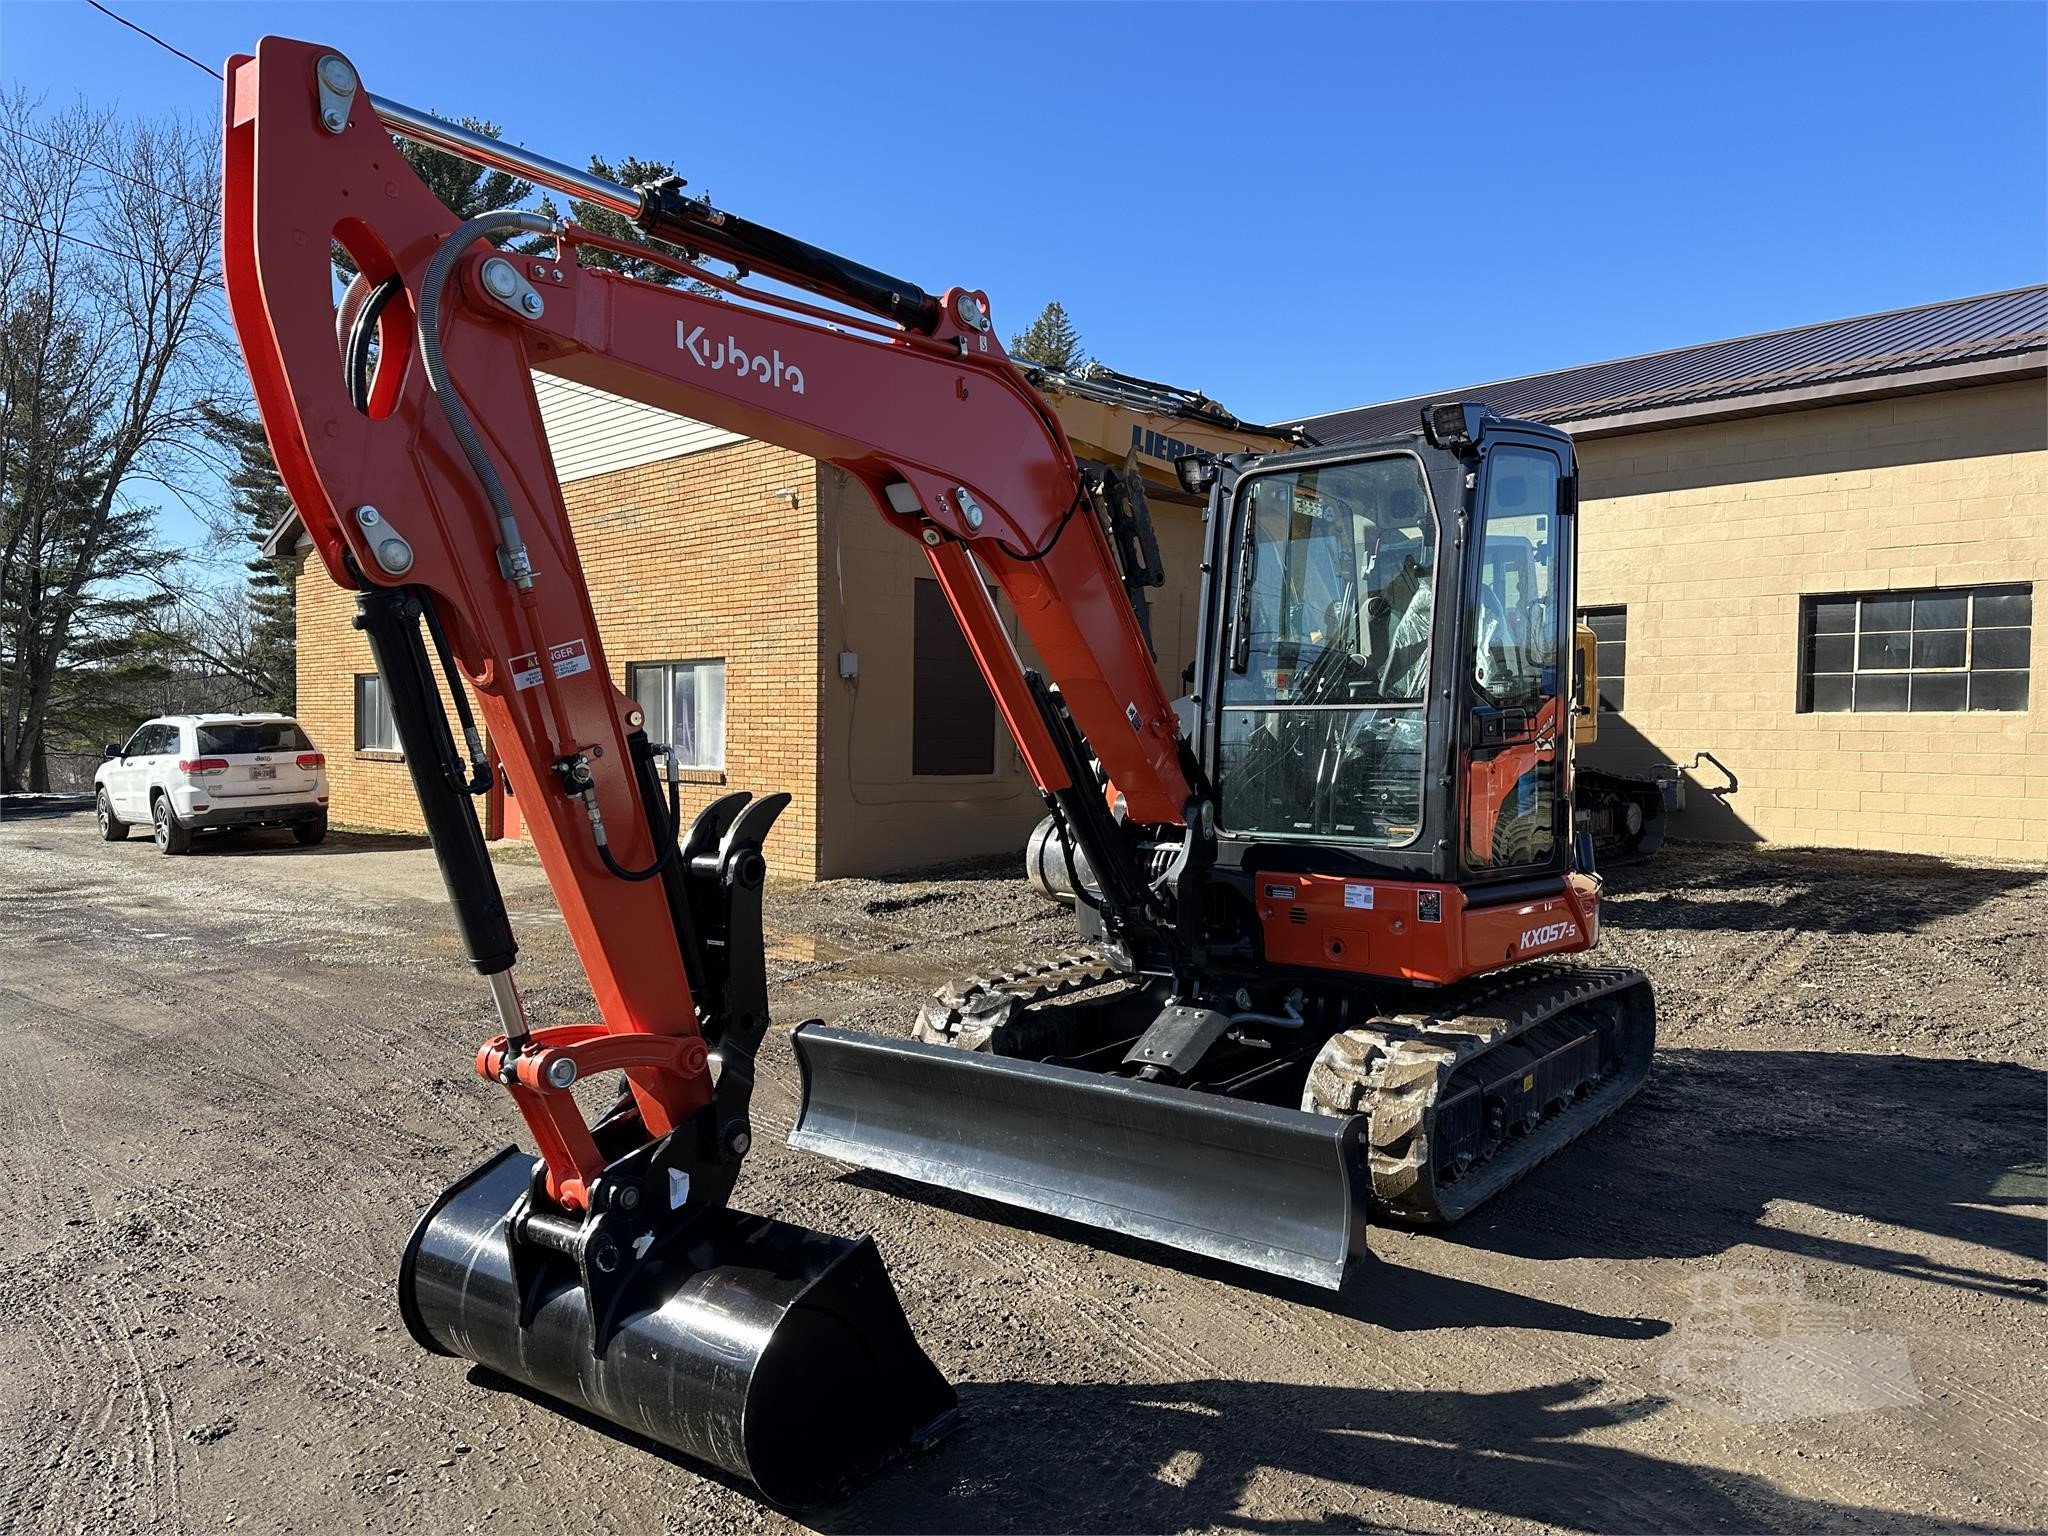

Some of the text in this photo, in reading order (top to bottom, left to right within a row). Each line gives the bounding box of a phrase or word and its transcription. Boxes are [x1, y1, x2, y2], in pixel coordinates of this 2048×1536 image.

[676, 320, 805, 394] Kubota
[1132, 425, 1215, 462] LIEB
[1520, 921, 1576, 950] KX057-5
